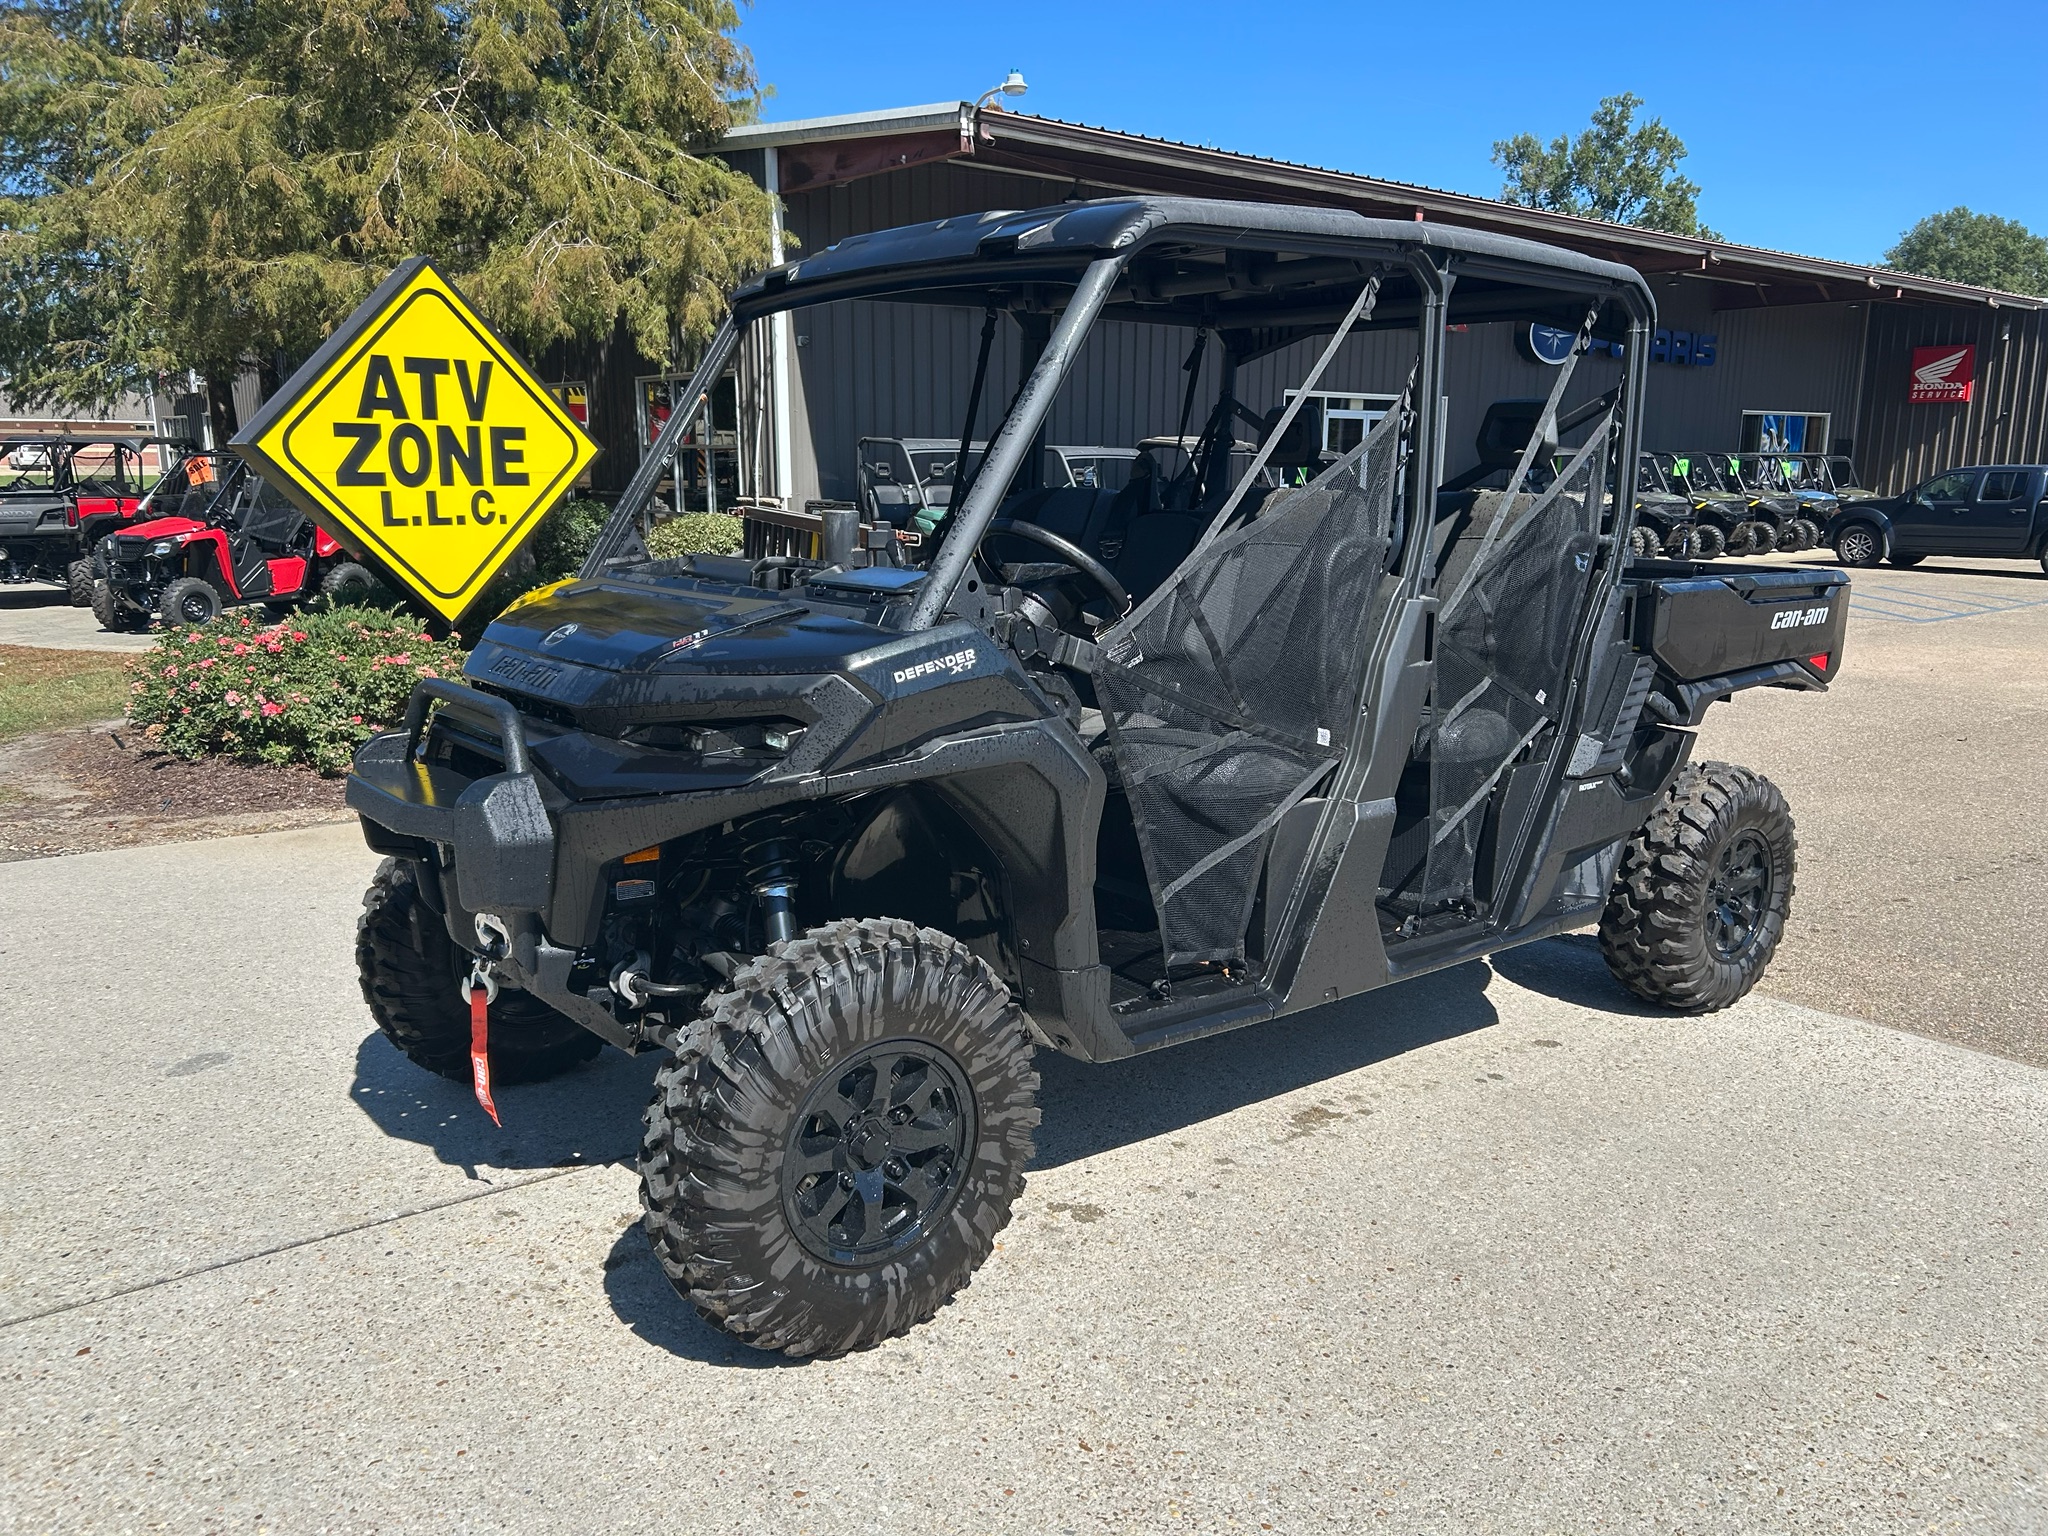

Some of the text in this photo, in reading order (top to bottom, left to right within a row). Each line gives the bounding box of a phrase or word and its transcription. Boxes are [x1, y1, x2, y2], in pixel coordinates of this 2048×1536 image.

[1588, 328, 1718, 366] PARIS
[356, 354, 494, 422] ATV
[1911, 390, 1965, 399] SERVICE
[1912, 382, 1965, 391] HONDA
[188, 459, 208, 475] SALE
[333, 422, 531, 488] ZONE
[380, 489, 508, 527] L.L.C.
[1770, 606, 1829, 630] can-am
[893, 648, 976, 684] DEFENDER
[949, 659, 977, 676] XT
